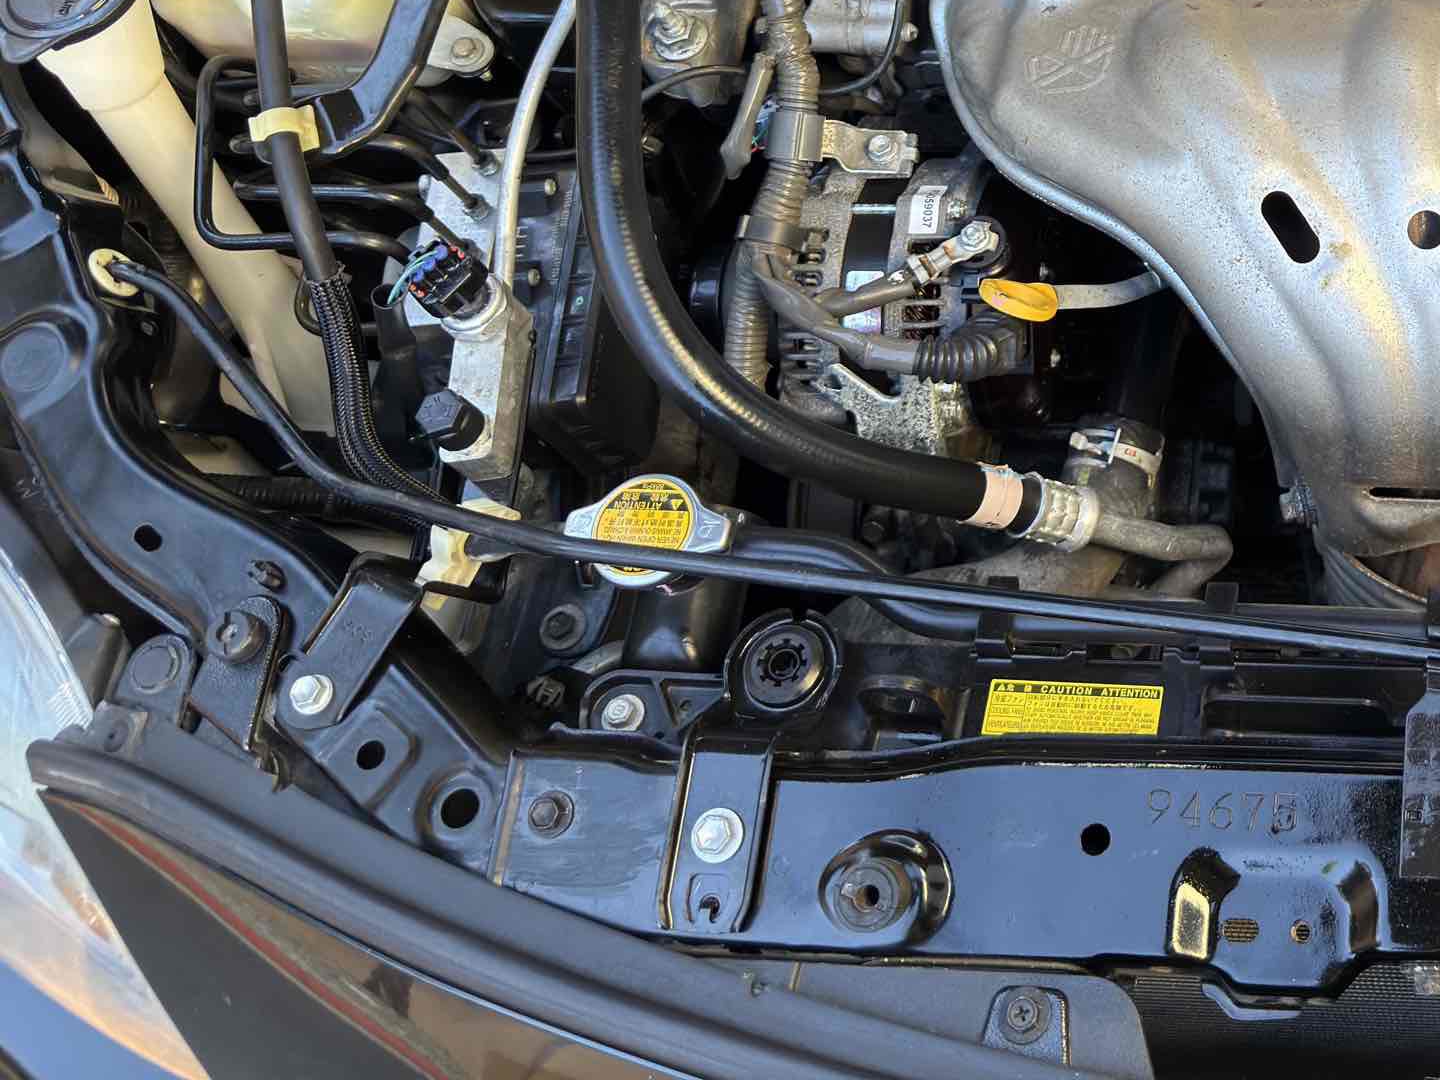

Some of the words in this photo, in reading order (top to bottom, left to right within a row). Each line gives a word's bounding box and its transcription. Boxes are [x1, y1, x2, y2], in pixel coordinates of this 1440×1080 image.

[614, 500, 663, 511] ATTENTION
[1040, 685, 1094, 696] CAUTION
[1100, 687, 1159, 699] ATTENTION
